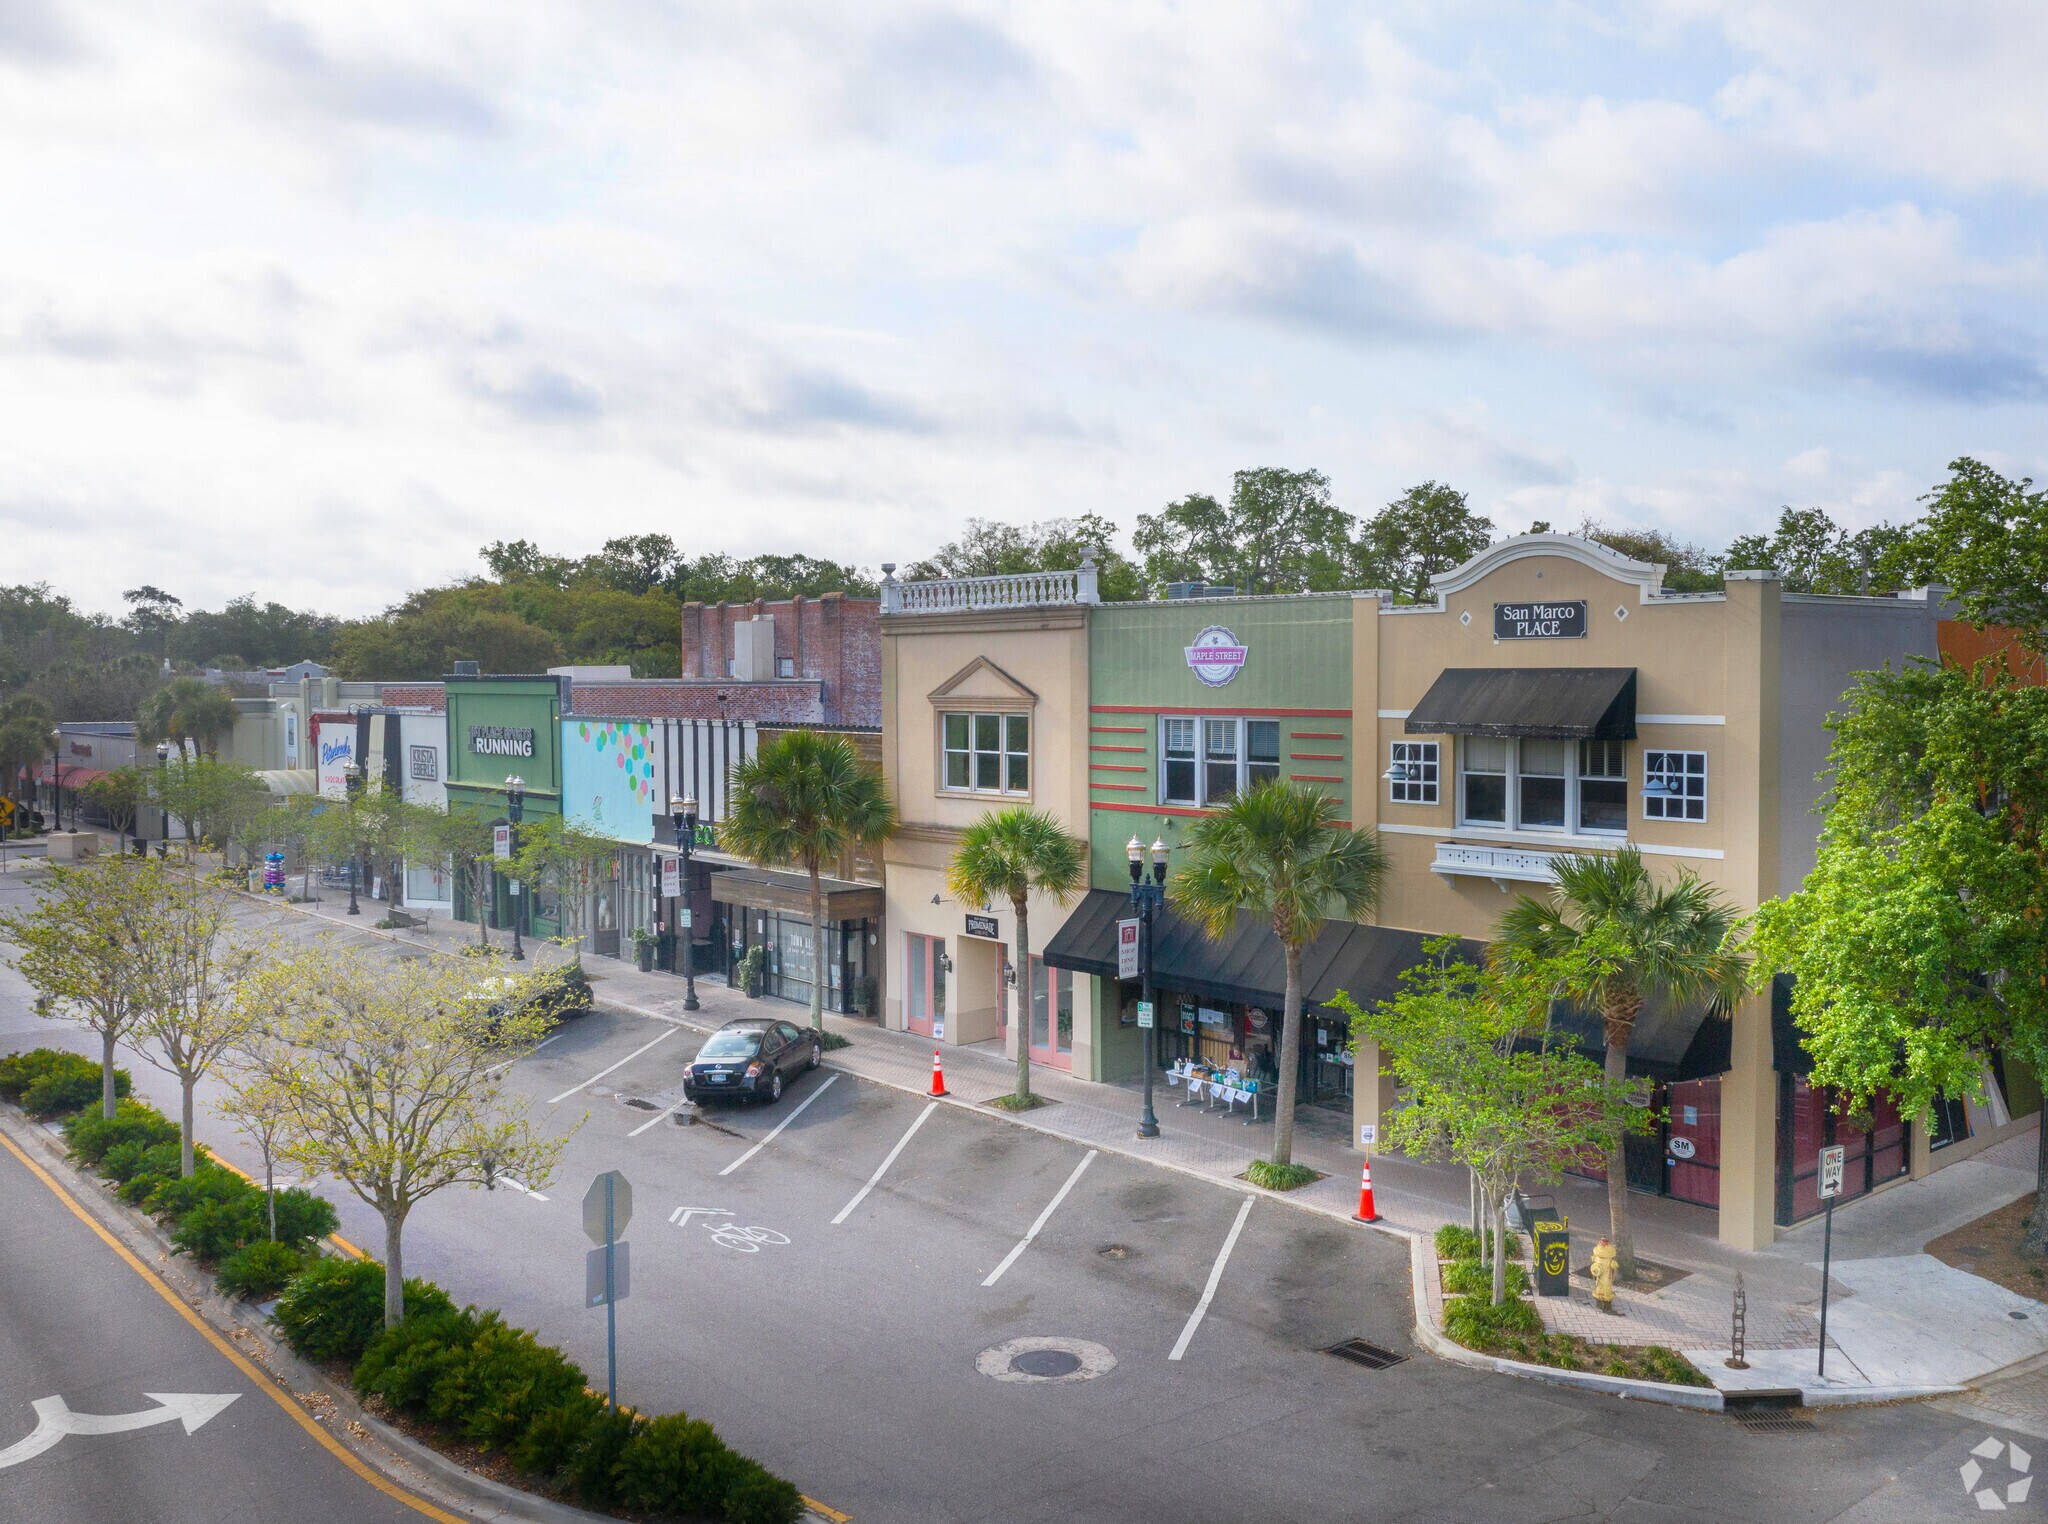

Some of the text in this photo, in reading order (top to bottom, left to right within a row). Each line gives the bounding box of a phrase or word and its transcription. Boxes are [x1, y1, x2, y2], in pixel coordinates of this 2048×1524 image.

[1503, 605, 1575, 620] San Marco
[1516, 621, 1561, 636] PLACE
[1190, 651, 1242, 661] MAPLE STREET
[504, 727, 532, 741] SPORTS
[476, 737, 532, 757] RUNNING
[412, 749, 434, 764] KRISTA
[413, 763, 435, 778] EBERLE
[968, 919, 995, 935] PROMENADE
[1121, 947, 1136, 955] SHOP
[1674, 1140, 1690, 1151] SM
[1825, 1152, 1842, 1166] ONE
[1825, 1165, 1842, 1179] WAY
